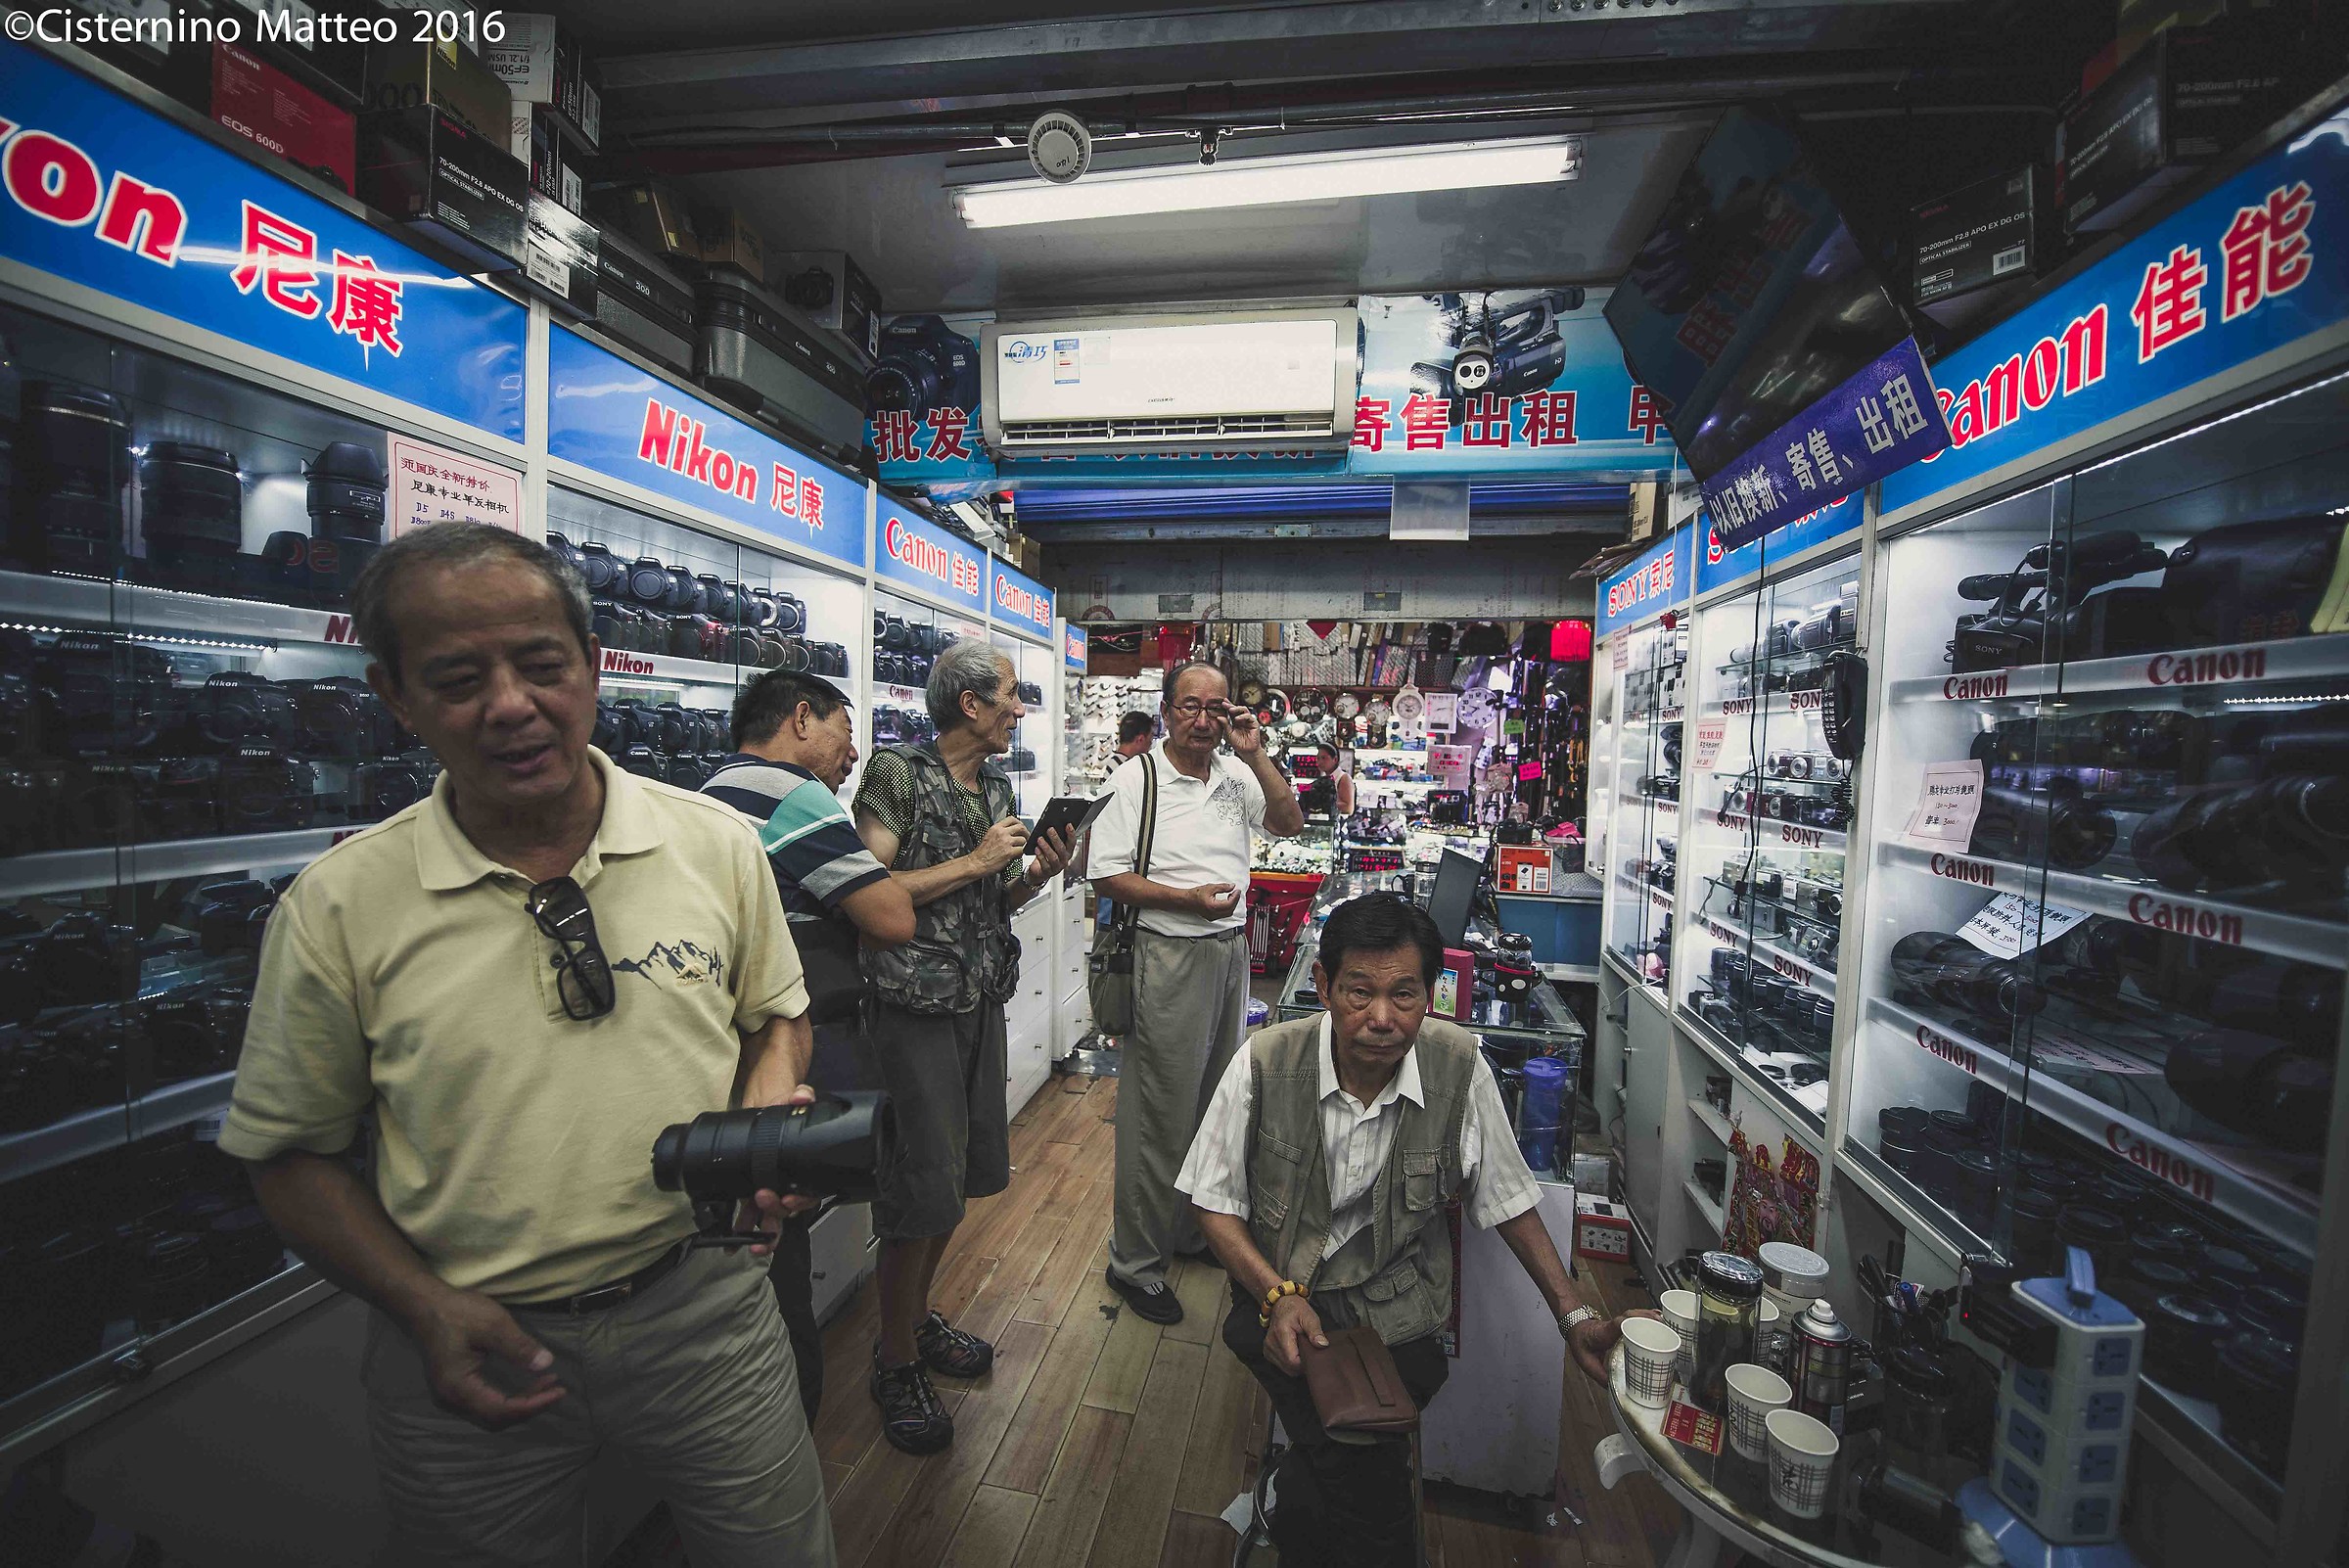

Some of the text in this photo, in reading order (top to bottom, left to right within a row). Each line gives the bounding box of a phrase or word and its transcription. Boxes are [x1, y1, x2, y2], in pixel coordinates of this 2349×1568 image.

[221, 43, 261, 70] Canon
[221, 115, 284, 154] EOS 600D
[0, 115, 188, 269] on
[438, 157, 471, 181] 70-200mm
[471, 174, 484, 189] F2.8
[484, 182, 497, 196] APO
[497, 191, 506, 202] EX
[506, 195, 516, 208] DG
[516, 202, 525, 213] OS
[440, 168, 460, 186] OPTICAL
[1919, 211, 2026, 254] 70-200mm F2.8 APO EX DG OS
[231, 199, 405, 359] 尼康
[603, 261, 650, 296] Canon 300
[2131, 180, 2316, 365] 佳能
[892, 326, 917, 335] Canon
[871, 405, 973, 464] 批发
[1351, 388, 1578, 452] 寄售出租
[637, 397, 759, 505] Nikon
[416, 502, 429, 513] D5
[440, 509, 455, 521] D4S
[770, 460, 824, 531] 尼康
[885, 517, 948, 582] Canon
[951, 551, 980, 596] 佳能
[1649, 550, 1676, 600] 索尼
[995, 574, 1033, 620] Canon
[1607, 566, 1649, 619] SONY
[1034, 593, 1050, 627] 佳能
[60, 640, 99, 650] Nikon
[604, 650, 654, 674] Nikon
[1066, 633, 1085, 660] Canon
[1975, 643, 2003, 655] SONY
[208, 679, 238, 688] Nikon
[2146, 648, 2267, 686] Canon
[889, 685, 913, 701] Canon
[1790, 690, 1822, 711] SON
[1944, 673, 2008, 701] Canon
[1662, 708, 1682, 722] SONY
[1723, 697, 1753, 715] SONY
[1658, 803, 1678, 815] SONY
[1716, 811, 1747, 832] SONY
[1781, 824, 1823, 849] SONY
[1931, 852, 1995, 887] Canon
[1652, 892, 1673, 911] SONY
[2129, 892, 2242, 945] Canon
[1710, 922, 1738, 948] SONY
[1773, 954, 1814, 987] SONY
[1916, 1025, 1977, 1076] Canon
[2106, 1122, 2215, 1203] Canon
